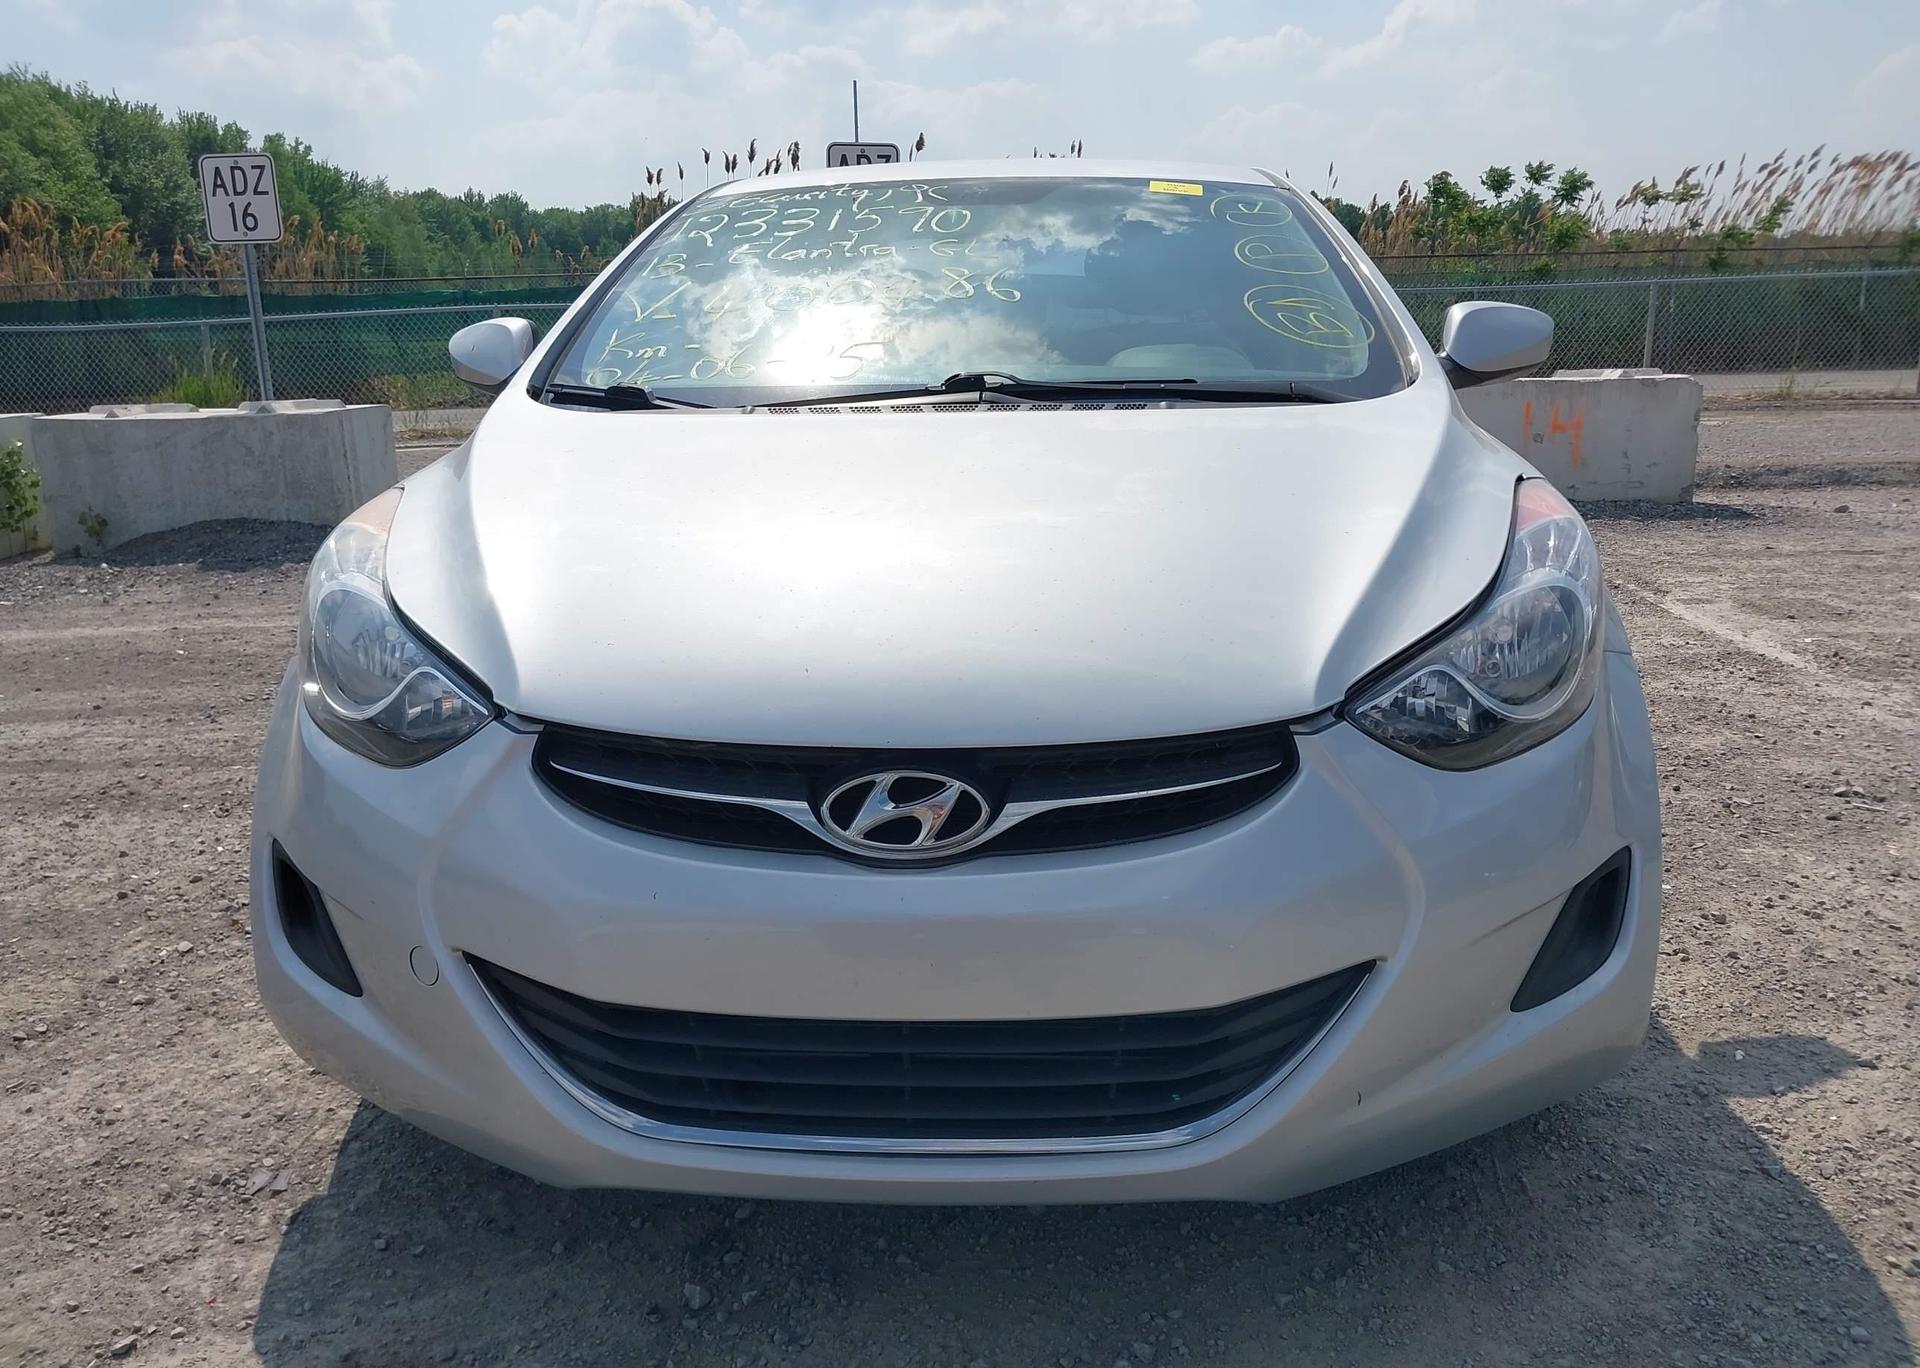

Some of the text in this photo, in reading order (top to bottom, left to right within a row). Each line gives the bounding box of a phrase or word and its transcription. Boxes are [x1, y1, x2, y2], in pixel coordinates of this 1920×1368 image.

[212, 164, 269, 197] ADZ
[228, 201, 259, 232] 16
[1522, 399, 1586, 472] 14
